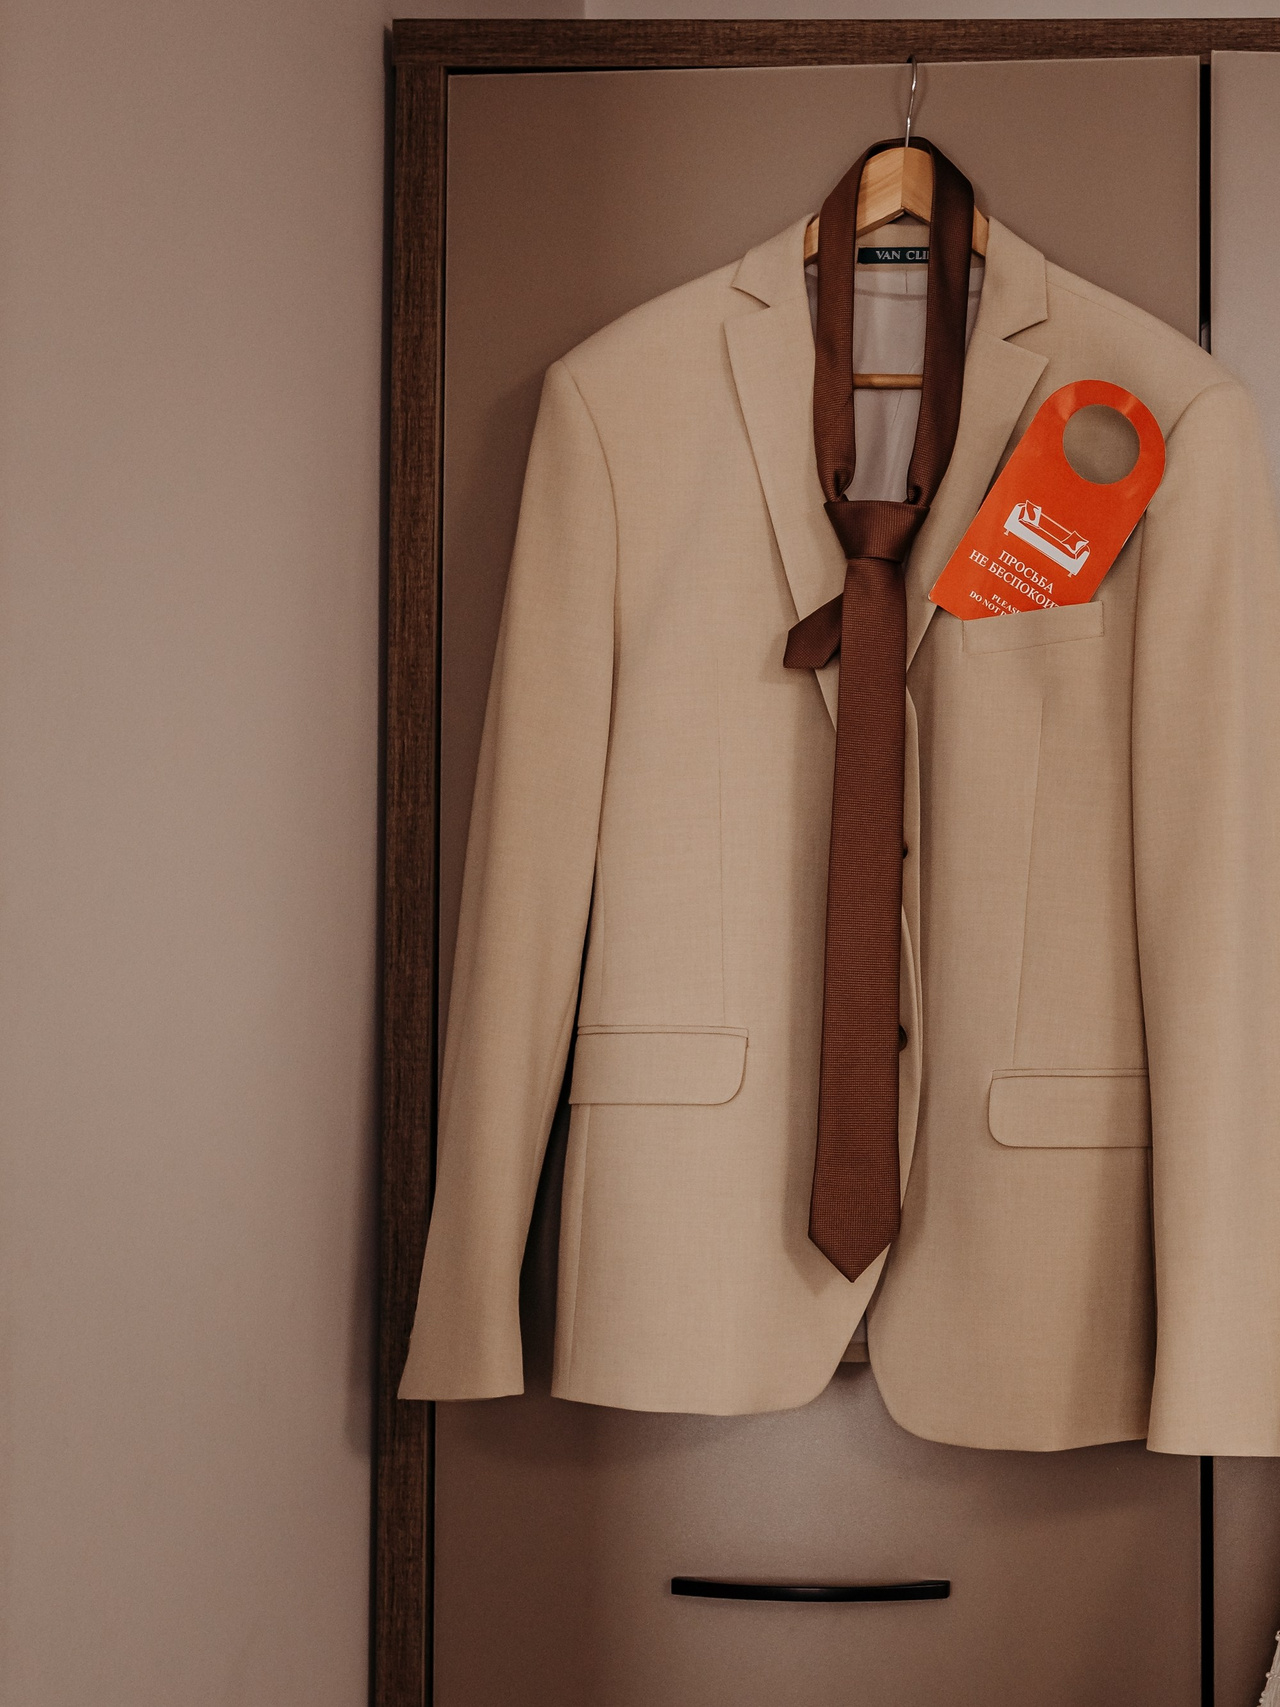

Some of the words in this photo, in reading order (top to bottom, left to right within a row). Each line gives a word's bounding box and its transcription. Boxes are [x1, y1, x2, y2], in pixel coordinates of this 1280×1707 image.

[876, 250, 901, 260] VAN
[969, 549, 989, 567] НЕ
[988, 562, 1060, 609] БЕСПОКОИ
[998, 550, 1054, 594] ПРОСЬБА
[969, 590, 983, 602] DO
[982, 598, 1001, 614] NOT
